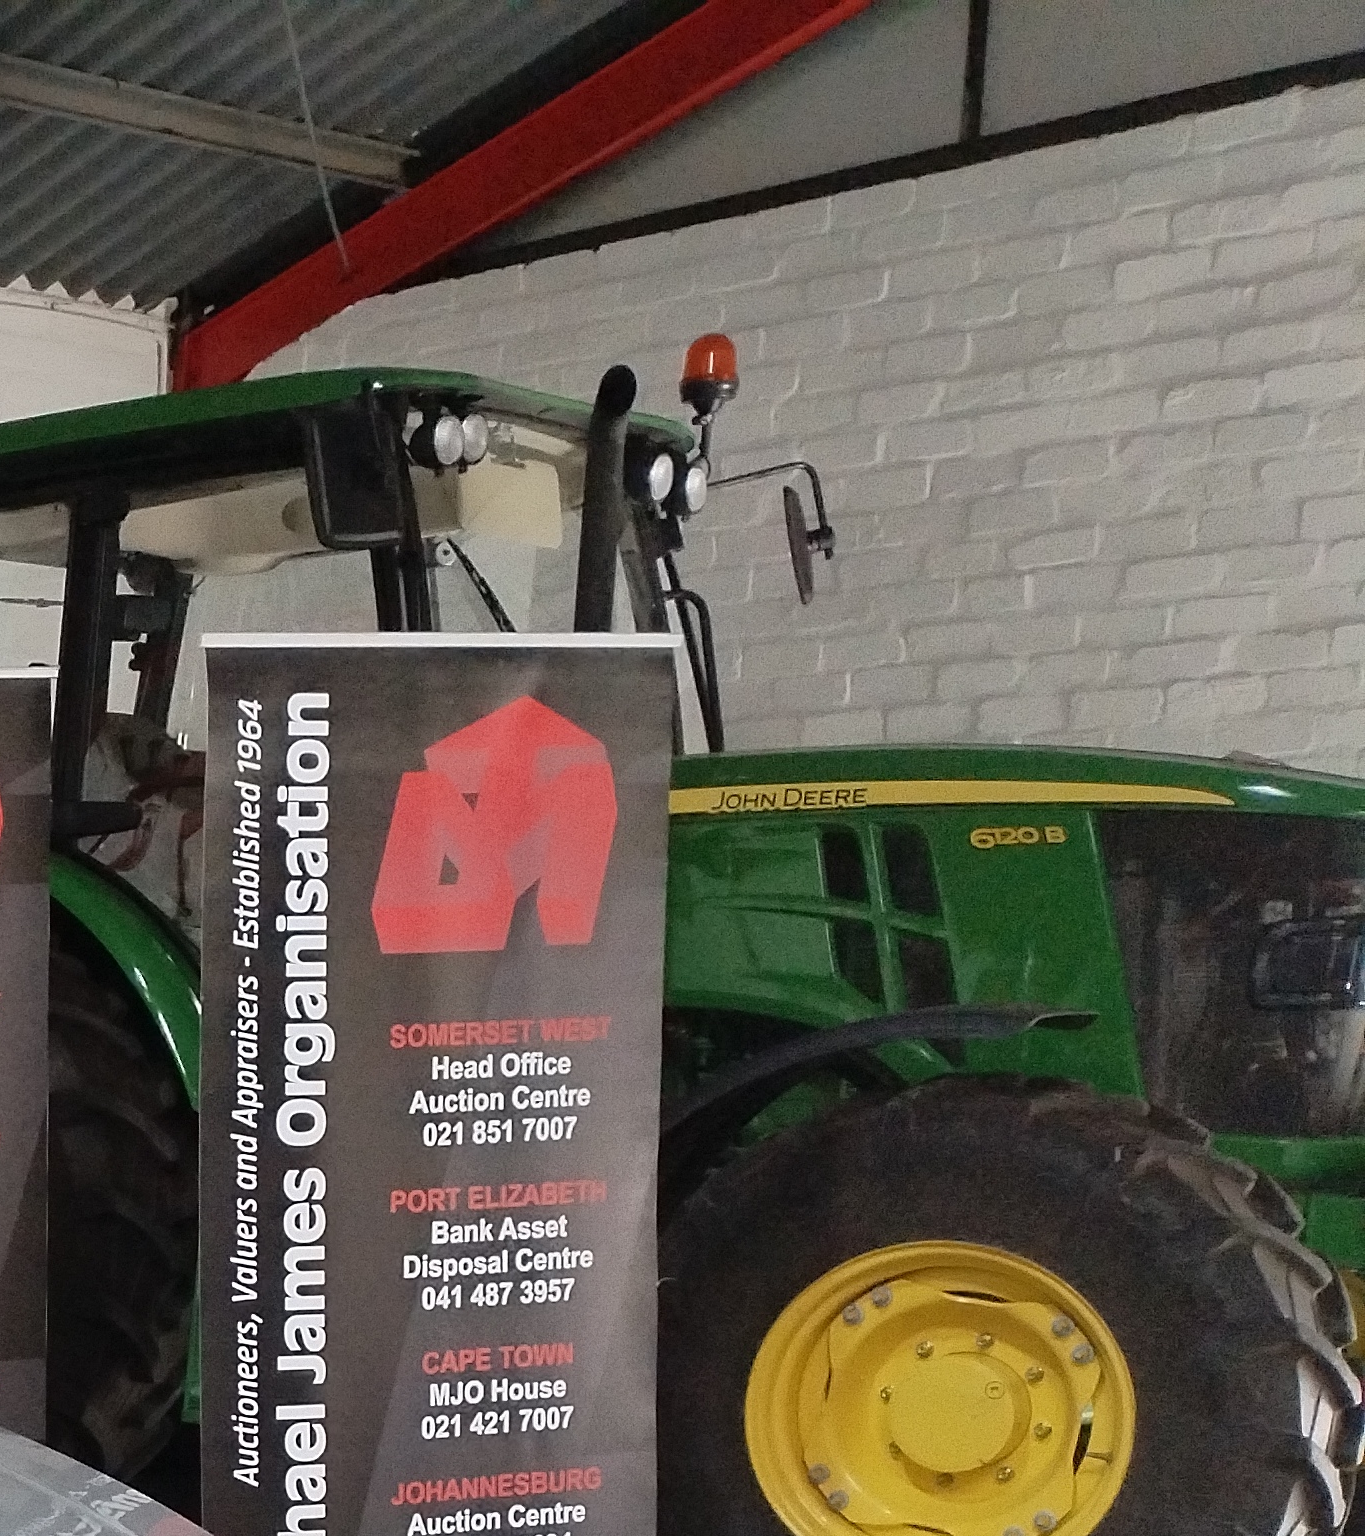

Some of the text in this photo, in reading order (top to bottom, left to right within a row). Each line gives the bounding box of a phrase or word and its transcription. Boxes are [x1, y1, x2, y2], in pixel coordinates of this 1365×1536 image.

[238, 699, 263, 772] 1964
[711, 787, 868, 811] JOHN DEERE
[1044, 825, 1067, 844] B
[232, 781, 261, 949] Established
[276, 692, 336, 1147] Organisation
[390, 1016, 611, 1048] SOMERSET WEST
[230, 974, 264, 1128] Appraisers
[432, 1052, 572, 1080] Head Office
[409, 1085, 591, 1114] Auction Centre
[423, 1116, 577, 1146] 021 851 7007
[230, 1133, 258, 1190] and
[390, 1180, 607, 1213] PORT ELIZABETH
[431, 1215, 568, 1244] Bank Asset
[230, 1198, 258, 1302] Valuers
[403, 1247, 593, 1281] Disposal Centre
[276, 1168, 327, 1384] James
[422, 1278, 575, 1310] 041 487 3957
[422, 1342, 573, 1375] CAPE TOWN
[231, 1313, 264, 1487] Auctioneers,
[429, 1378, 567, 1406] MJO House
[421, 1406, 574, 1439] 021 421 7007
[391, 1467, 602, 1506] JOHANNESBURG
[407, 1502, 586, 1536] Auction Centre
